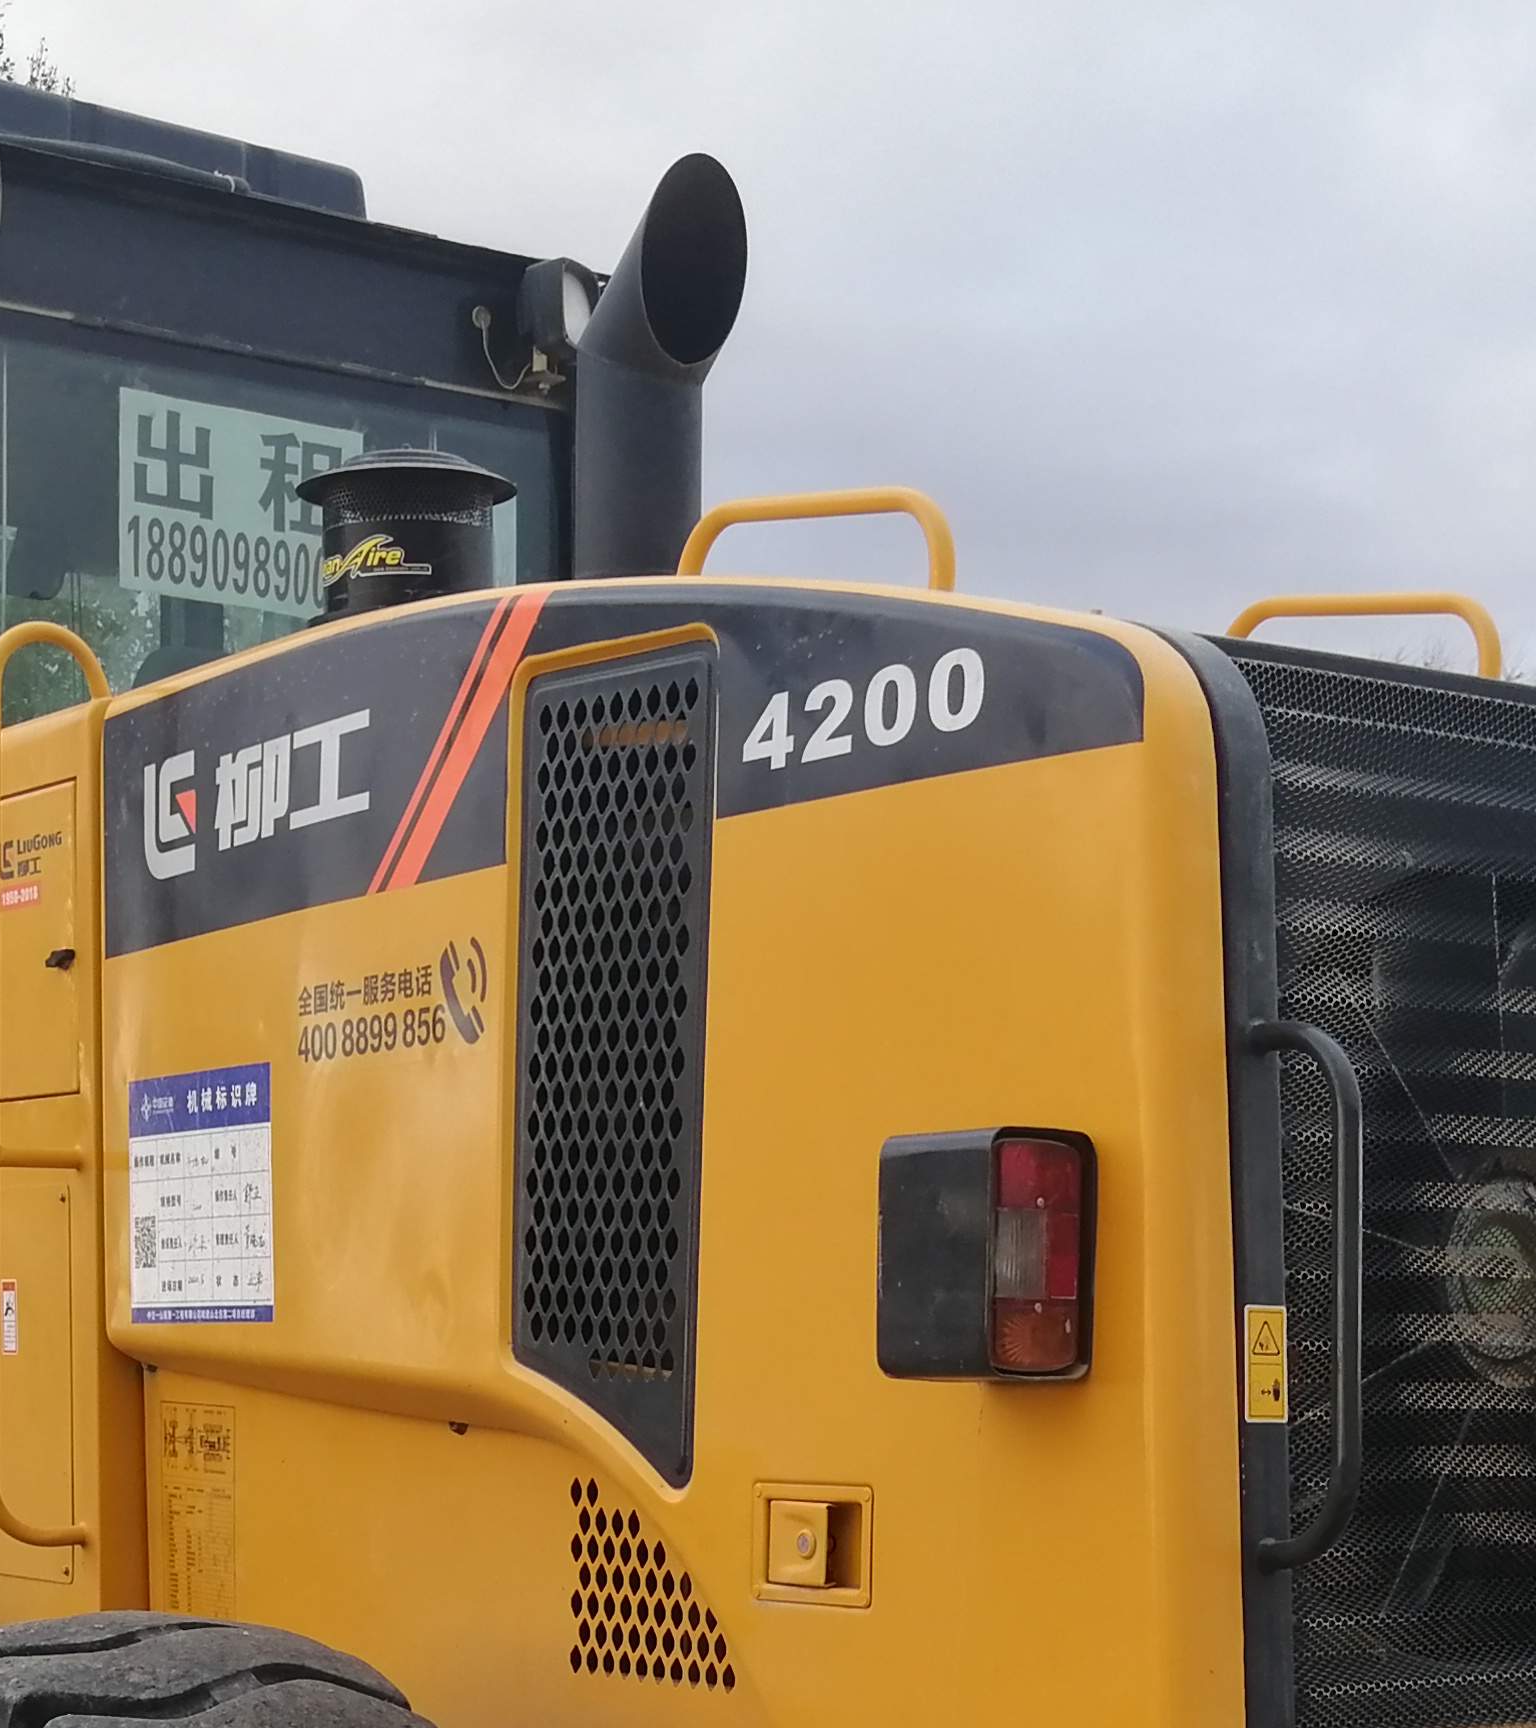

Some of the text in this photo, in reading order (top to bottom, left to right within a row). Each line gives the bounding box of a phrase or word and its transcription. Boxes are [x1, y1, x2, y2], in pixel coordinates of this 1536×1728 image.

[134, 410, 342, 534] 出租
[742, 647, 985, 771] 4200
[215, 709, 370, 851] 柳工
[298, 965, 432, 1017] 全国统一服务电话
[298, 1004, 446, 1064] 400 8899 856
[187, 1082, 257, 1114] 机械标识牌
